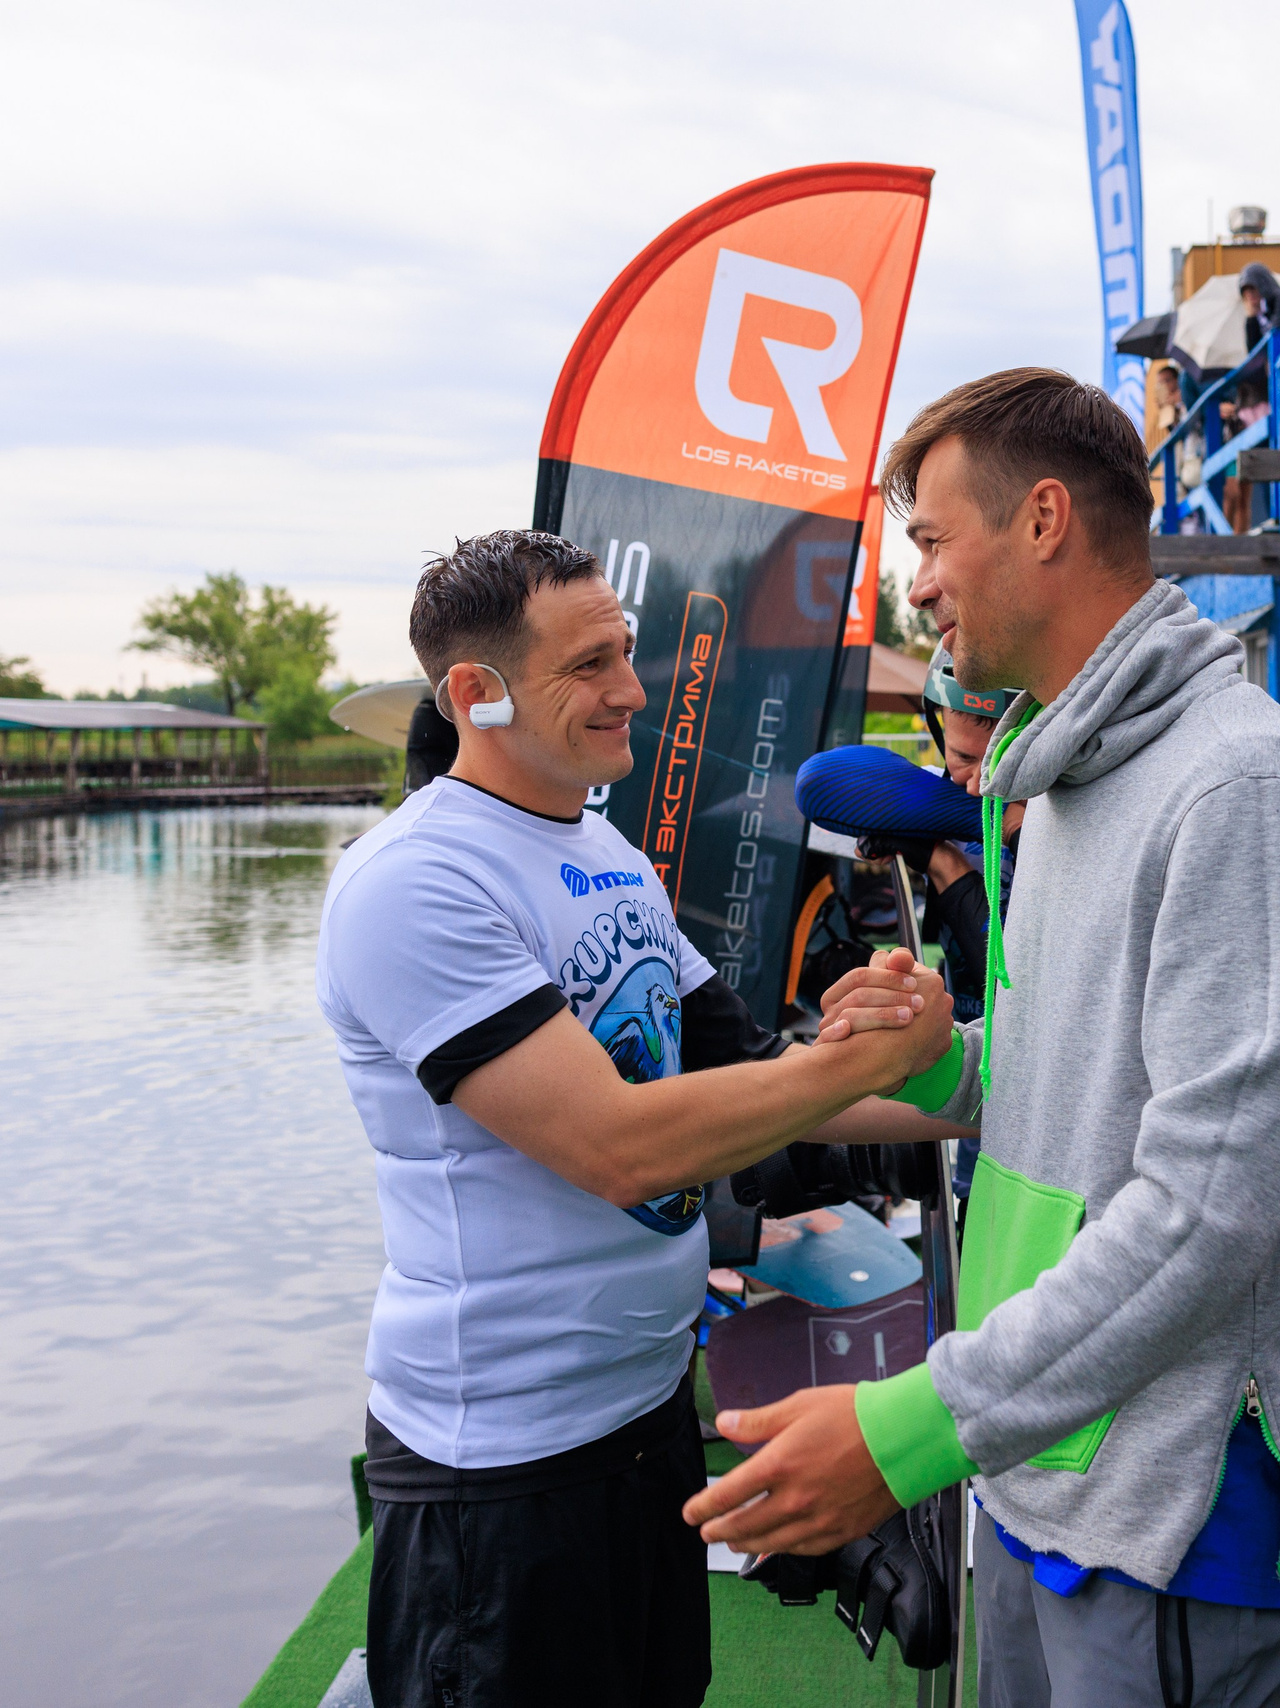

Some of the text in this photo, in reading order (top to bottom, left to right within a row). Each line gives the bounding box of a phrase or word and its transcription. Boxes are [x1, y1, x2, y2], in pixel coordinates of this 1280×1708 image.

[681, 441, 848, 491] LOS RAKETOS
[963, 693, 996, 712] TSG
[716, 697, 784, 990] aketos.com
[556, 899, 682, 1017] KUPCHIN
